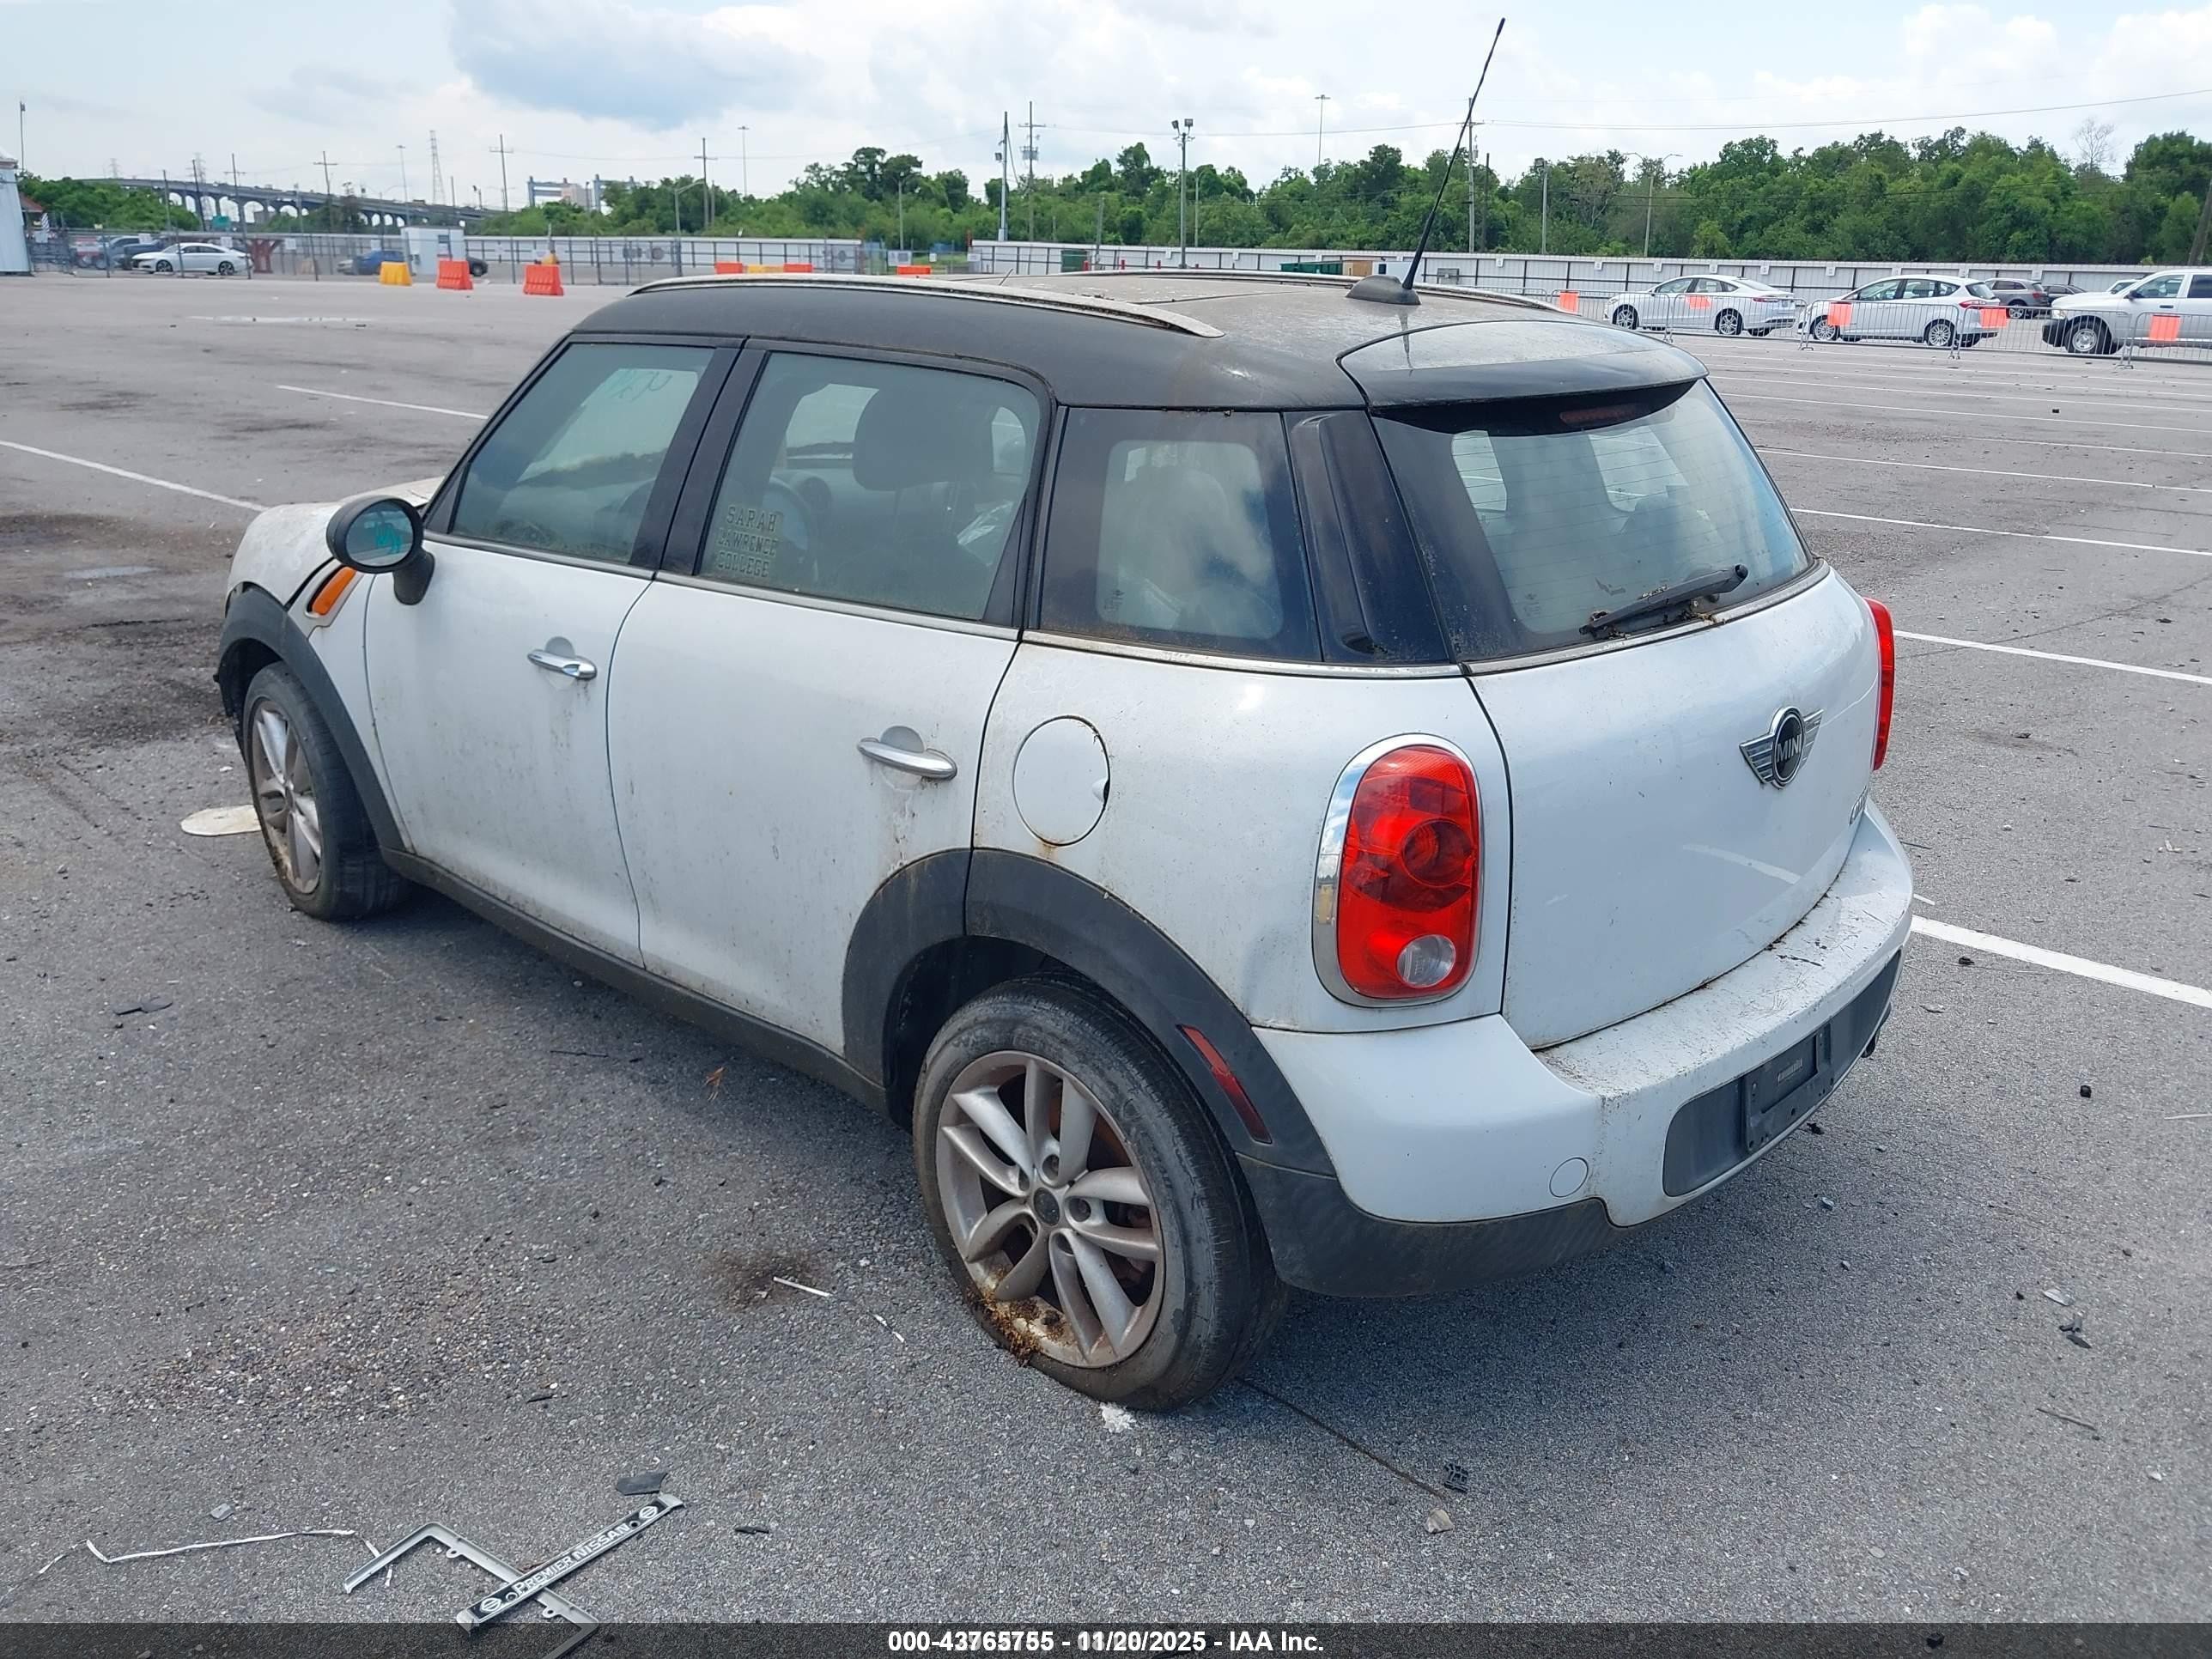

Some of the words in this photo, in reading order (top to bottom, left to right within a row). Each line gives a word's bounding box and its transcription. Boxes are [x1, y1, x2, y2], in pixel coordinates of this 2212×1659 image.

[726, 506, 777, 532] SARAH
[717, 527, 779, 557] LAWRENCE
[717, 550, 770, 578] COLLEGE
[1777, 733, 1802, 763] MINI
[513, 1555, 574, 1595] PREMIER
[573, 1522, 631, 1561] NISSAN
